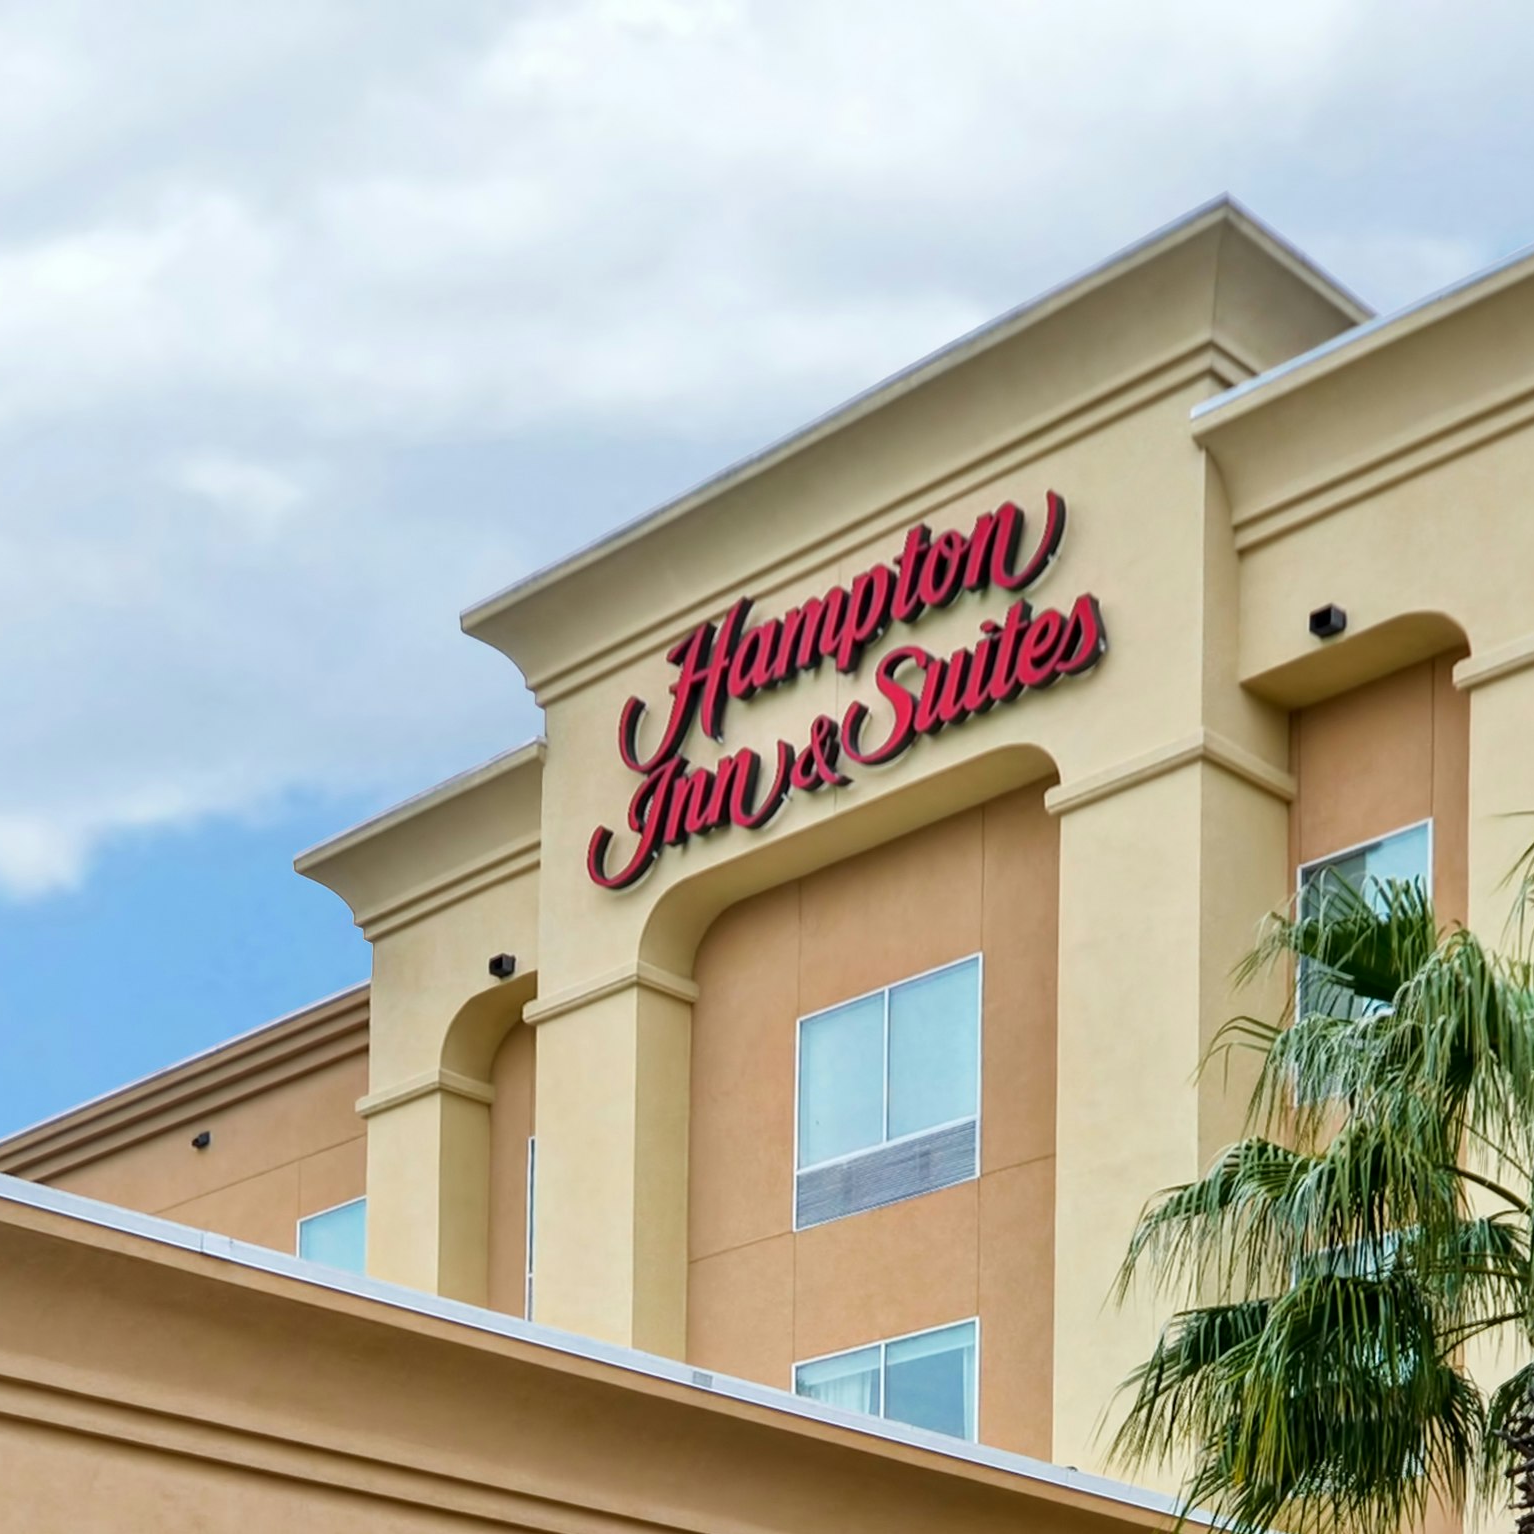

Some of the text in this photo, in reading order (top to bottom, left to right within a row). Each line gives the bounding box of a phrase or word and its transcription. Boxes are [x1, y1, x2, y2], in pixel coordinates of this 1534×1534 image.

[586, 592, 1107, 890] Inn & Suites
[618, 488, 1067, 774] Hampton
